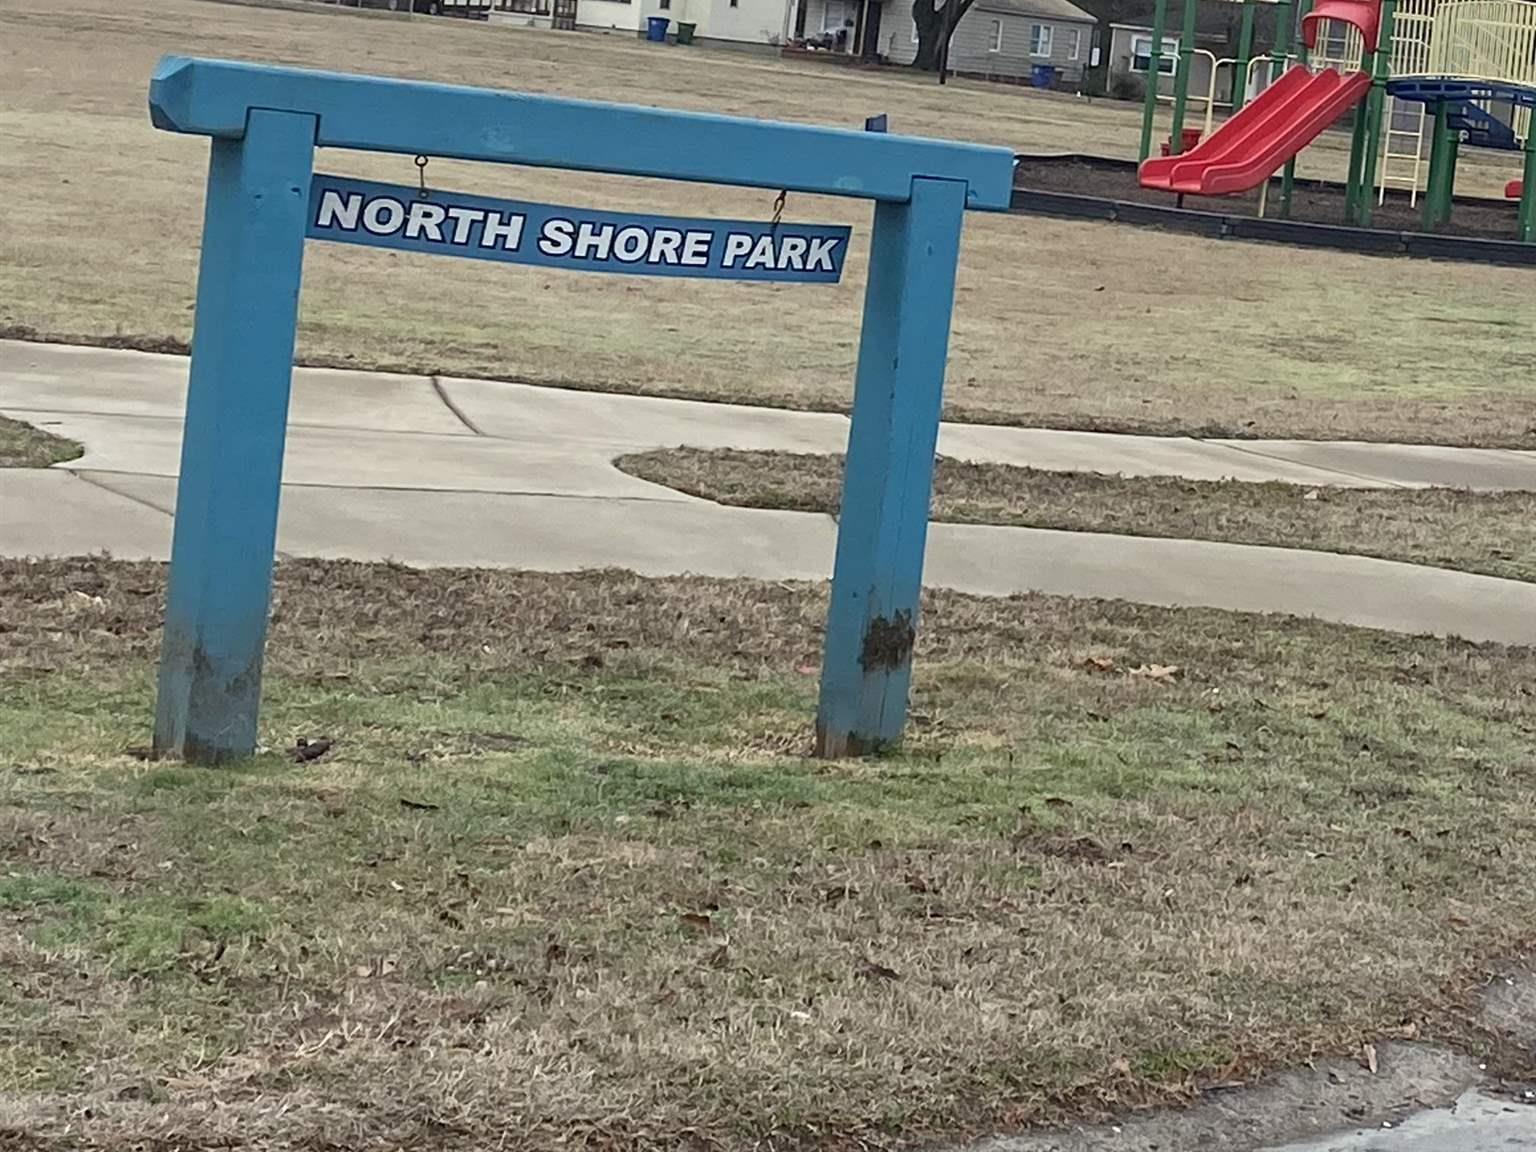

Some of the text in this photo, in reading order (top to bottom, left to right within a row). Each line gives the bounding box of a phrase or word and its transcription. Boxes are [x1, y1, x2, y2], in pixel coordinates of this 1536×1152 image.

[315, 190, 840, 271] NORTH SHORE PARK
